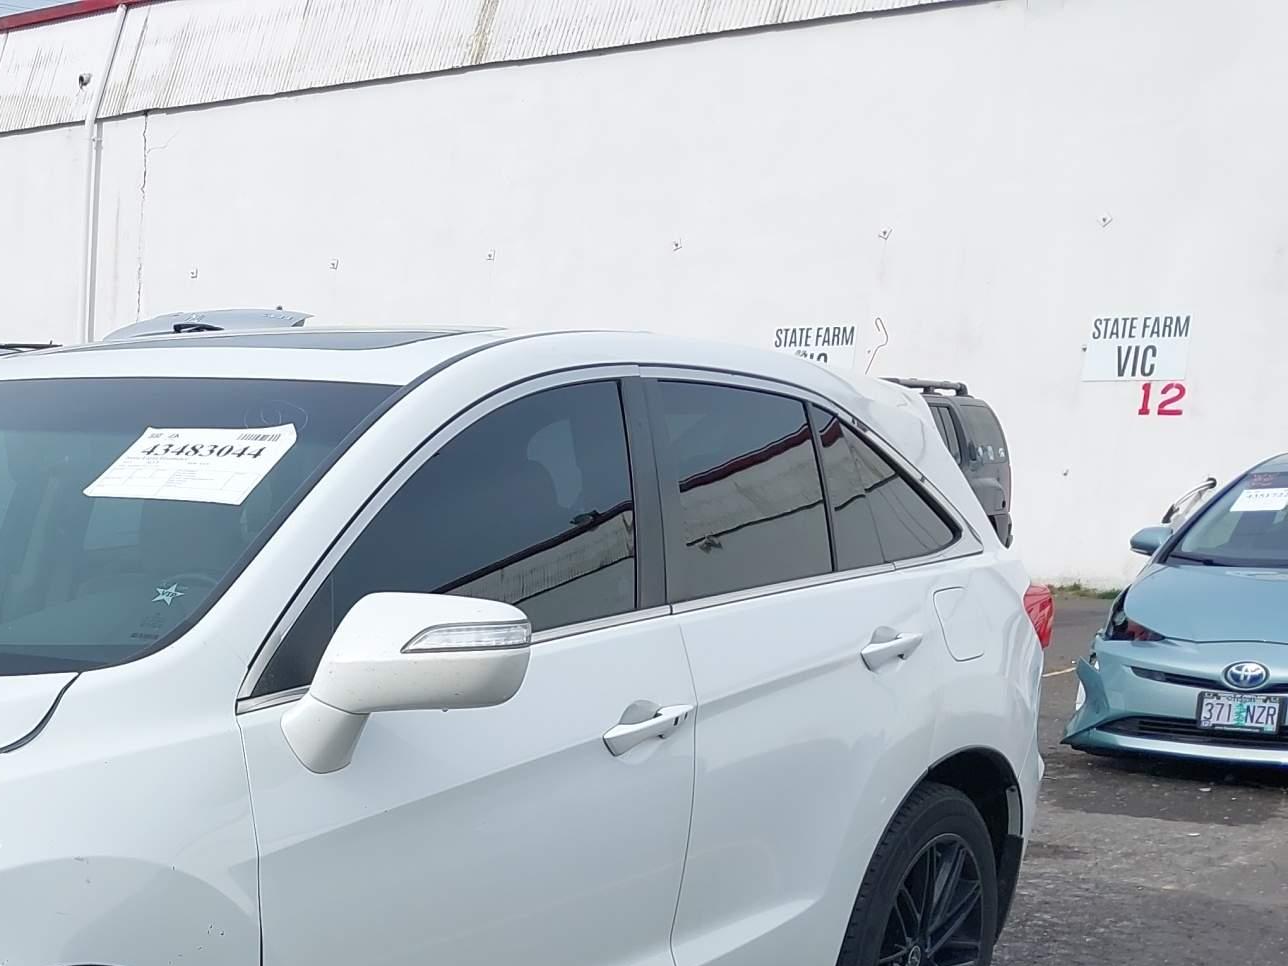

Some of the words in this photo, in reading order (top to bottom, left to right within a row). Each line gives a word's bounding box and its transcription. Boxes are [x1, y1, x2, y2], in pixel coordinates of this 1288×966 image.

[774, 328, 813, 348] STATE
[815, 326, 855, 347] FARM
[1092, 316, 1138, 340] STATE
[1141, 314, 1192, 338] FARM
[1117, 345, 1158, 378] VIC
[1138, 382, 1187, 416] 12
[141, 443, 266, 459] 43483044
[1203, 702, 1232, 722] 371
[1245, 705, 1277, 725] NZR
